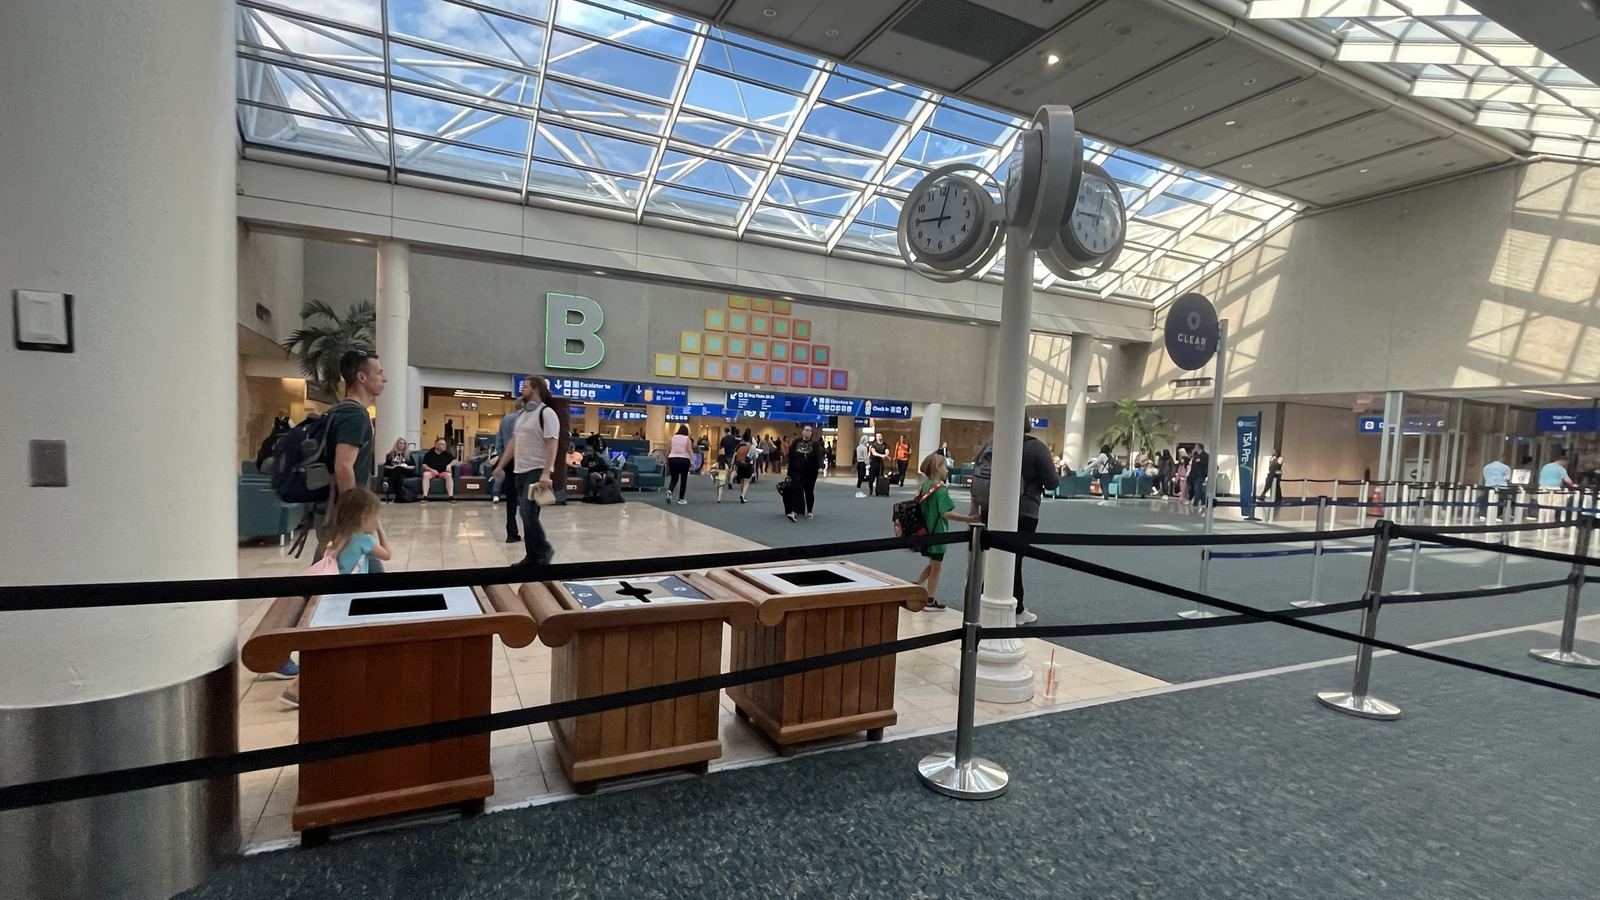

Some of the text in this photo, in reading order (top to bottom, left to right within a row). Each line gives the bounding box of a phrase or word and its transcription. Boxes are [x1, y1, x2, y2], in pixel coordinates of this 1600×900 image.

[940, 187, 948, 197] 12
[928, 192, 935, 202] 11
[962, 197, 968, 206] 2
[918, 204, 926, 213] 10
[965, 210, 971, 219] 3
[915, 219, 920, 227] 9
[961, 224, 966, 232] 4
[918, 231, 923, 239] 8
[950, 235, 956, 243] 5
[926, 238, 931, 247] 7
[937, 241, 943, 250] 6
[545, 292, 605, 370] B
[1177, 333, 1207, 346] CLEAR
[580, 381, 604, 389] Escalator
[1243, 432, 1252, 448] TSA
[1241, 448, 1252, 463] Pre
